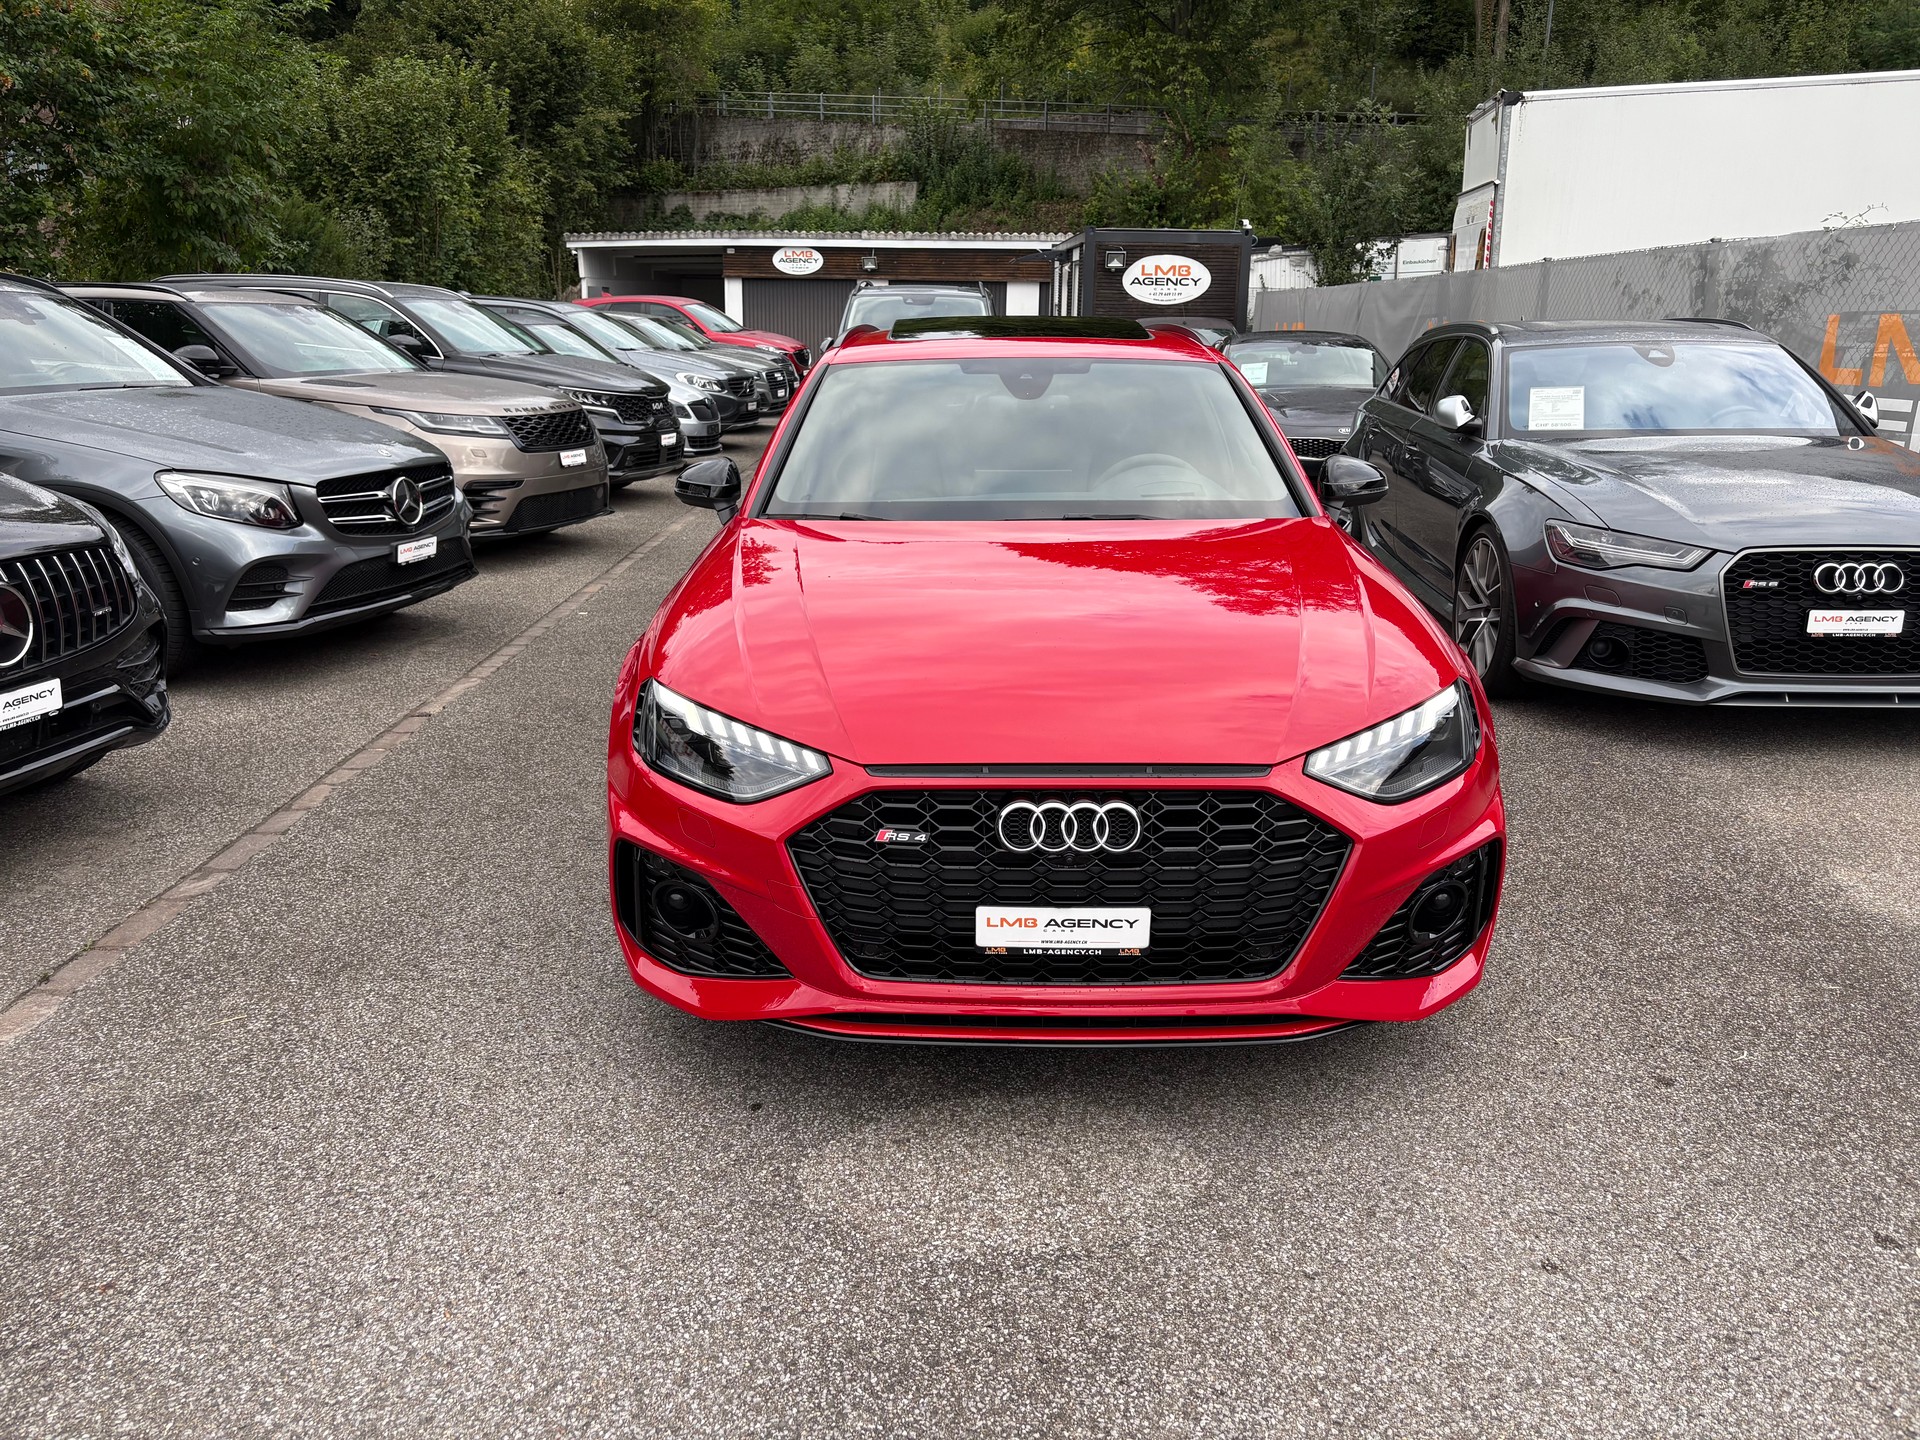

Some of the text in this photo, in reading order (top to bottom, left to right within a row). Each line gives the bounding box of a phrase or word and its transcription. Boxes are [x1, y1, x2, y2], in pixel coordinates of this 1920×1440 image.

[1141, 265, 1191, 276] LMB
[1130, 277, 1202, 286] AGENCY
[2, 687, 55, 710] AGENCY
[879, 830, 927, 842] RS 4
[986, 917, 1139, 929] LMB AGENCY
